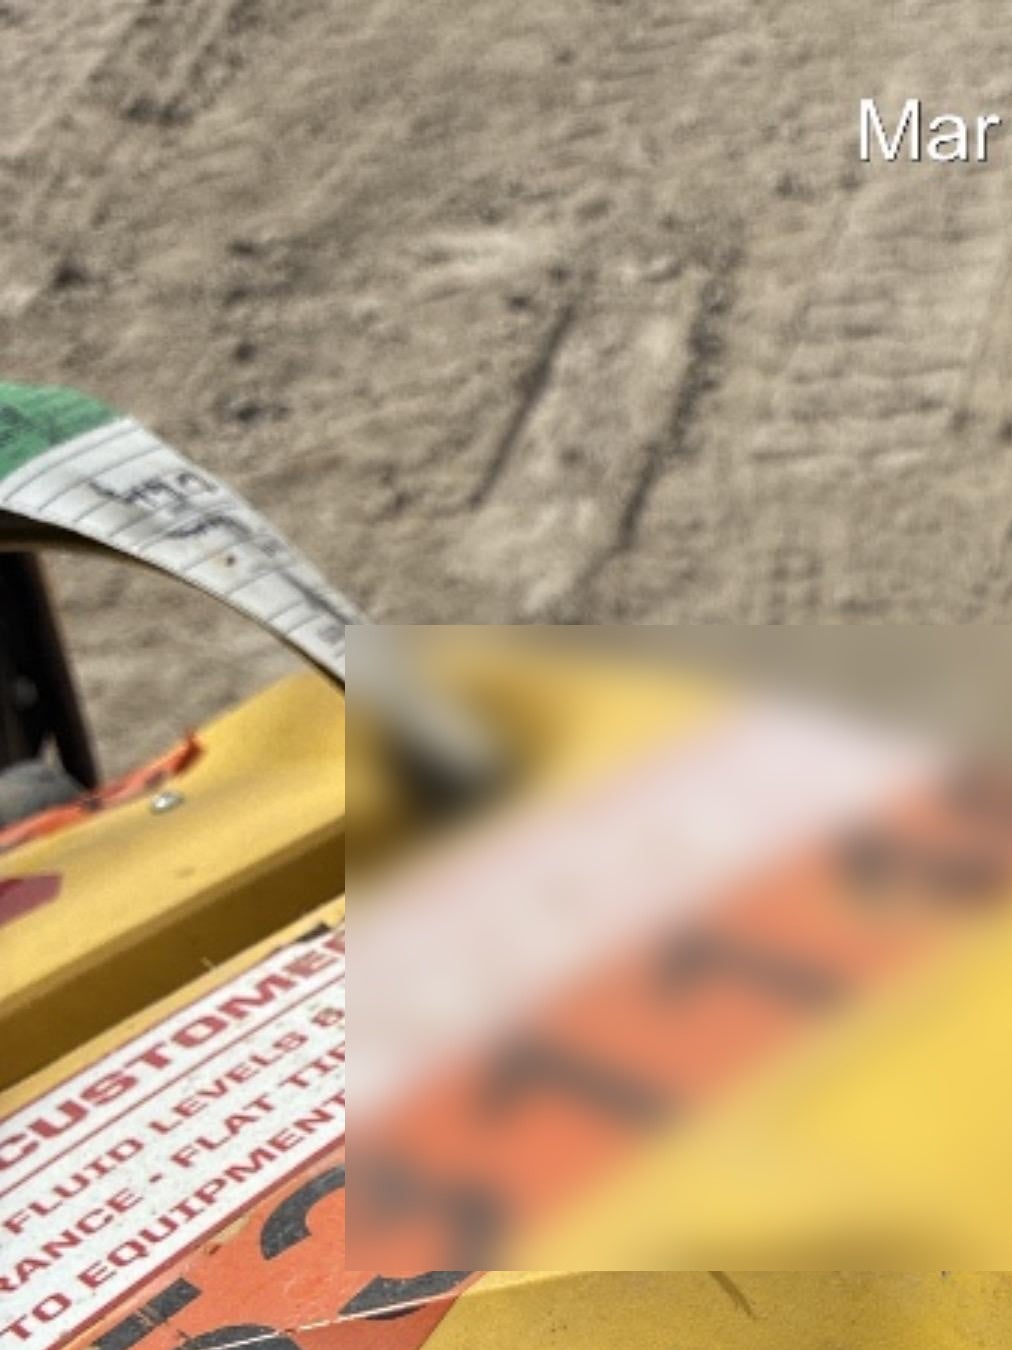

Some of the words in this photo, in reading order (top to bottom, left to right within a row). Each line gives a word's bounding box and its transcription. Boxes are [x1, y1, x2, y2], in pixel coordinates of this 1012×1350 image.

[0, 1293, 72, 1340] TO
[77, 1088, 345, 1289] EQUIPMENT
[3, 1138, 144, 1235] FLUID
[148, 1032, 309, 1134] LEVELS
[169, 1093, 275, 1168] FLAT
